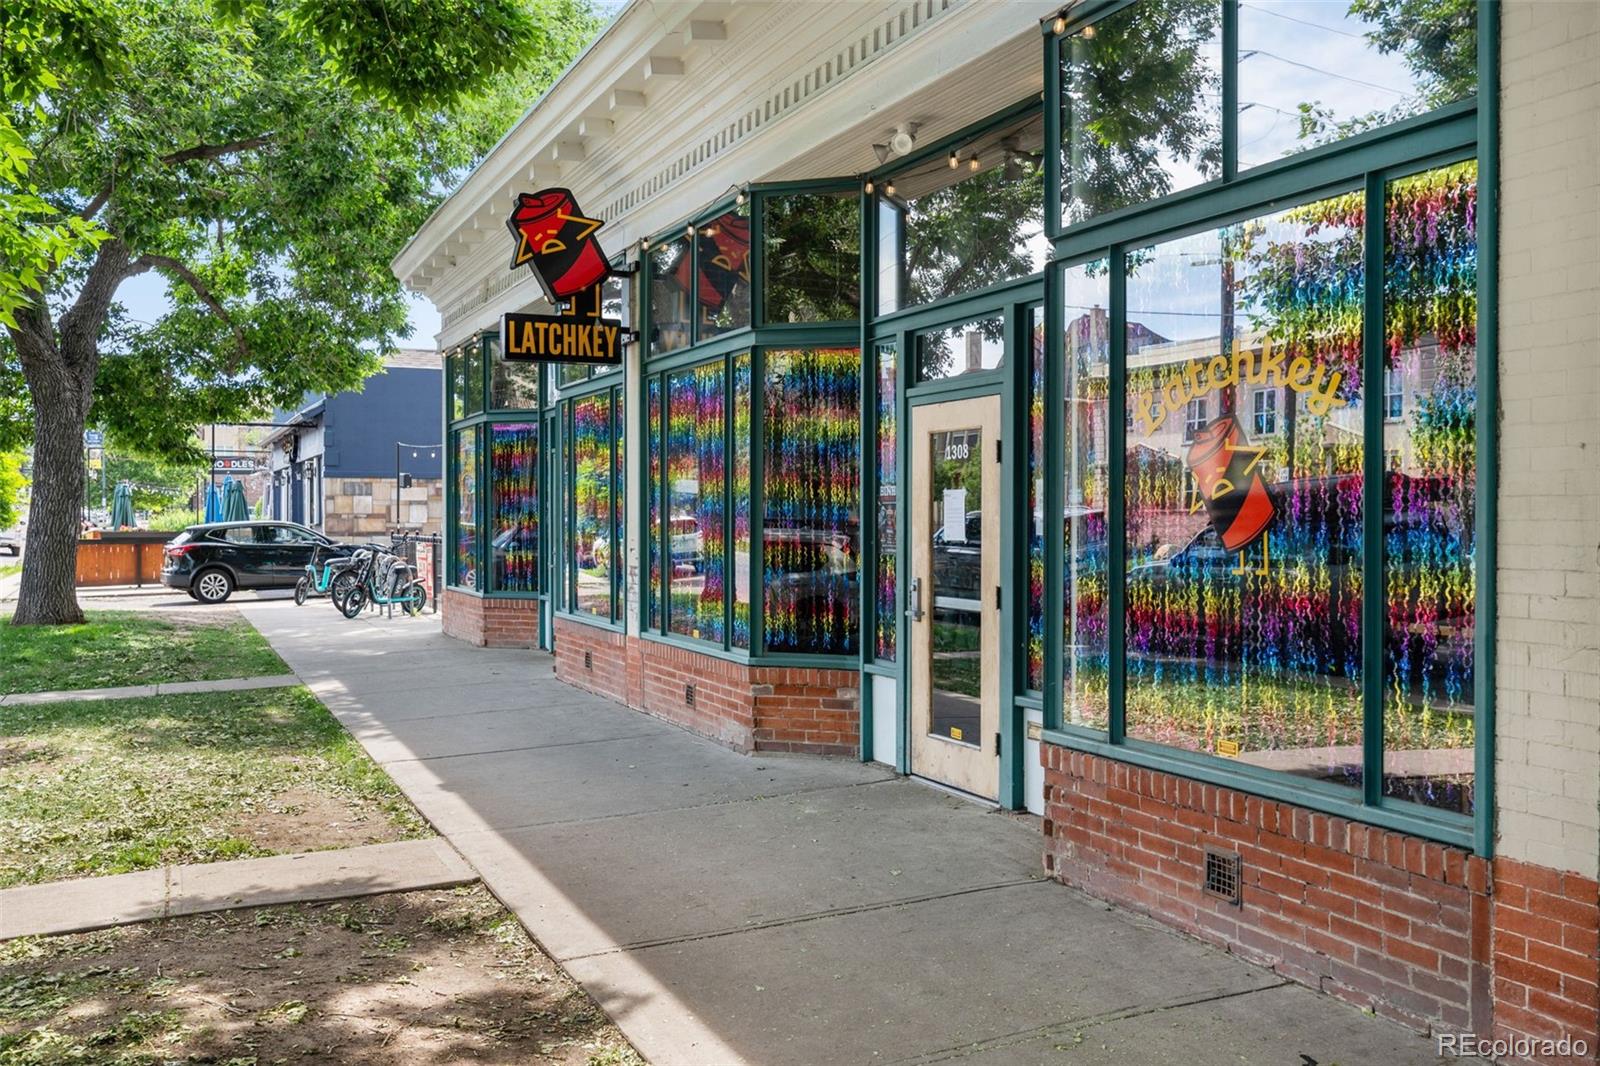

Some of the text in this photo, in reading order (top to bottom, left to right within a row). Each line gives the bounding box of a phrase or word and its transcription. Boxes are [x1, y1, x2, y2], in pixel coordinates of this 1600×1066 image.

[509, 320, 618, 358] LATCHKEY
[1135, 337, 1348, 438] Latchkey
[946, 443, 969, 460] 1308
